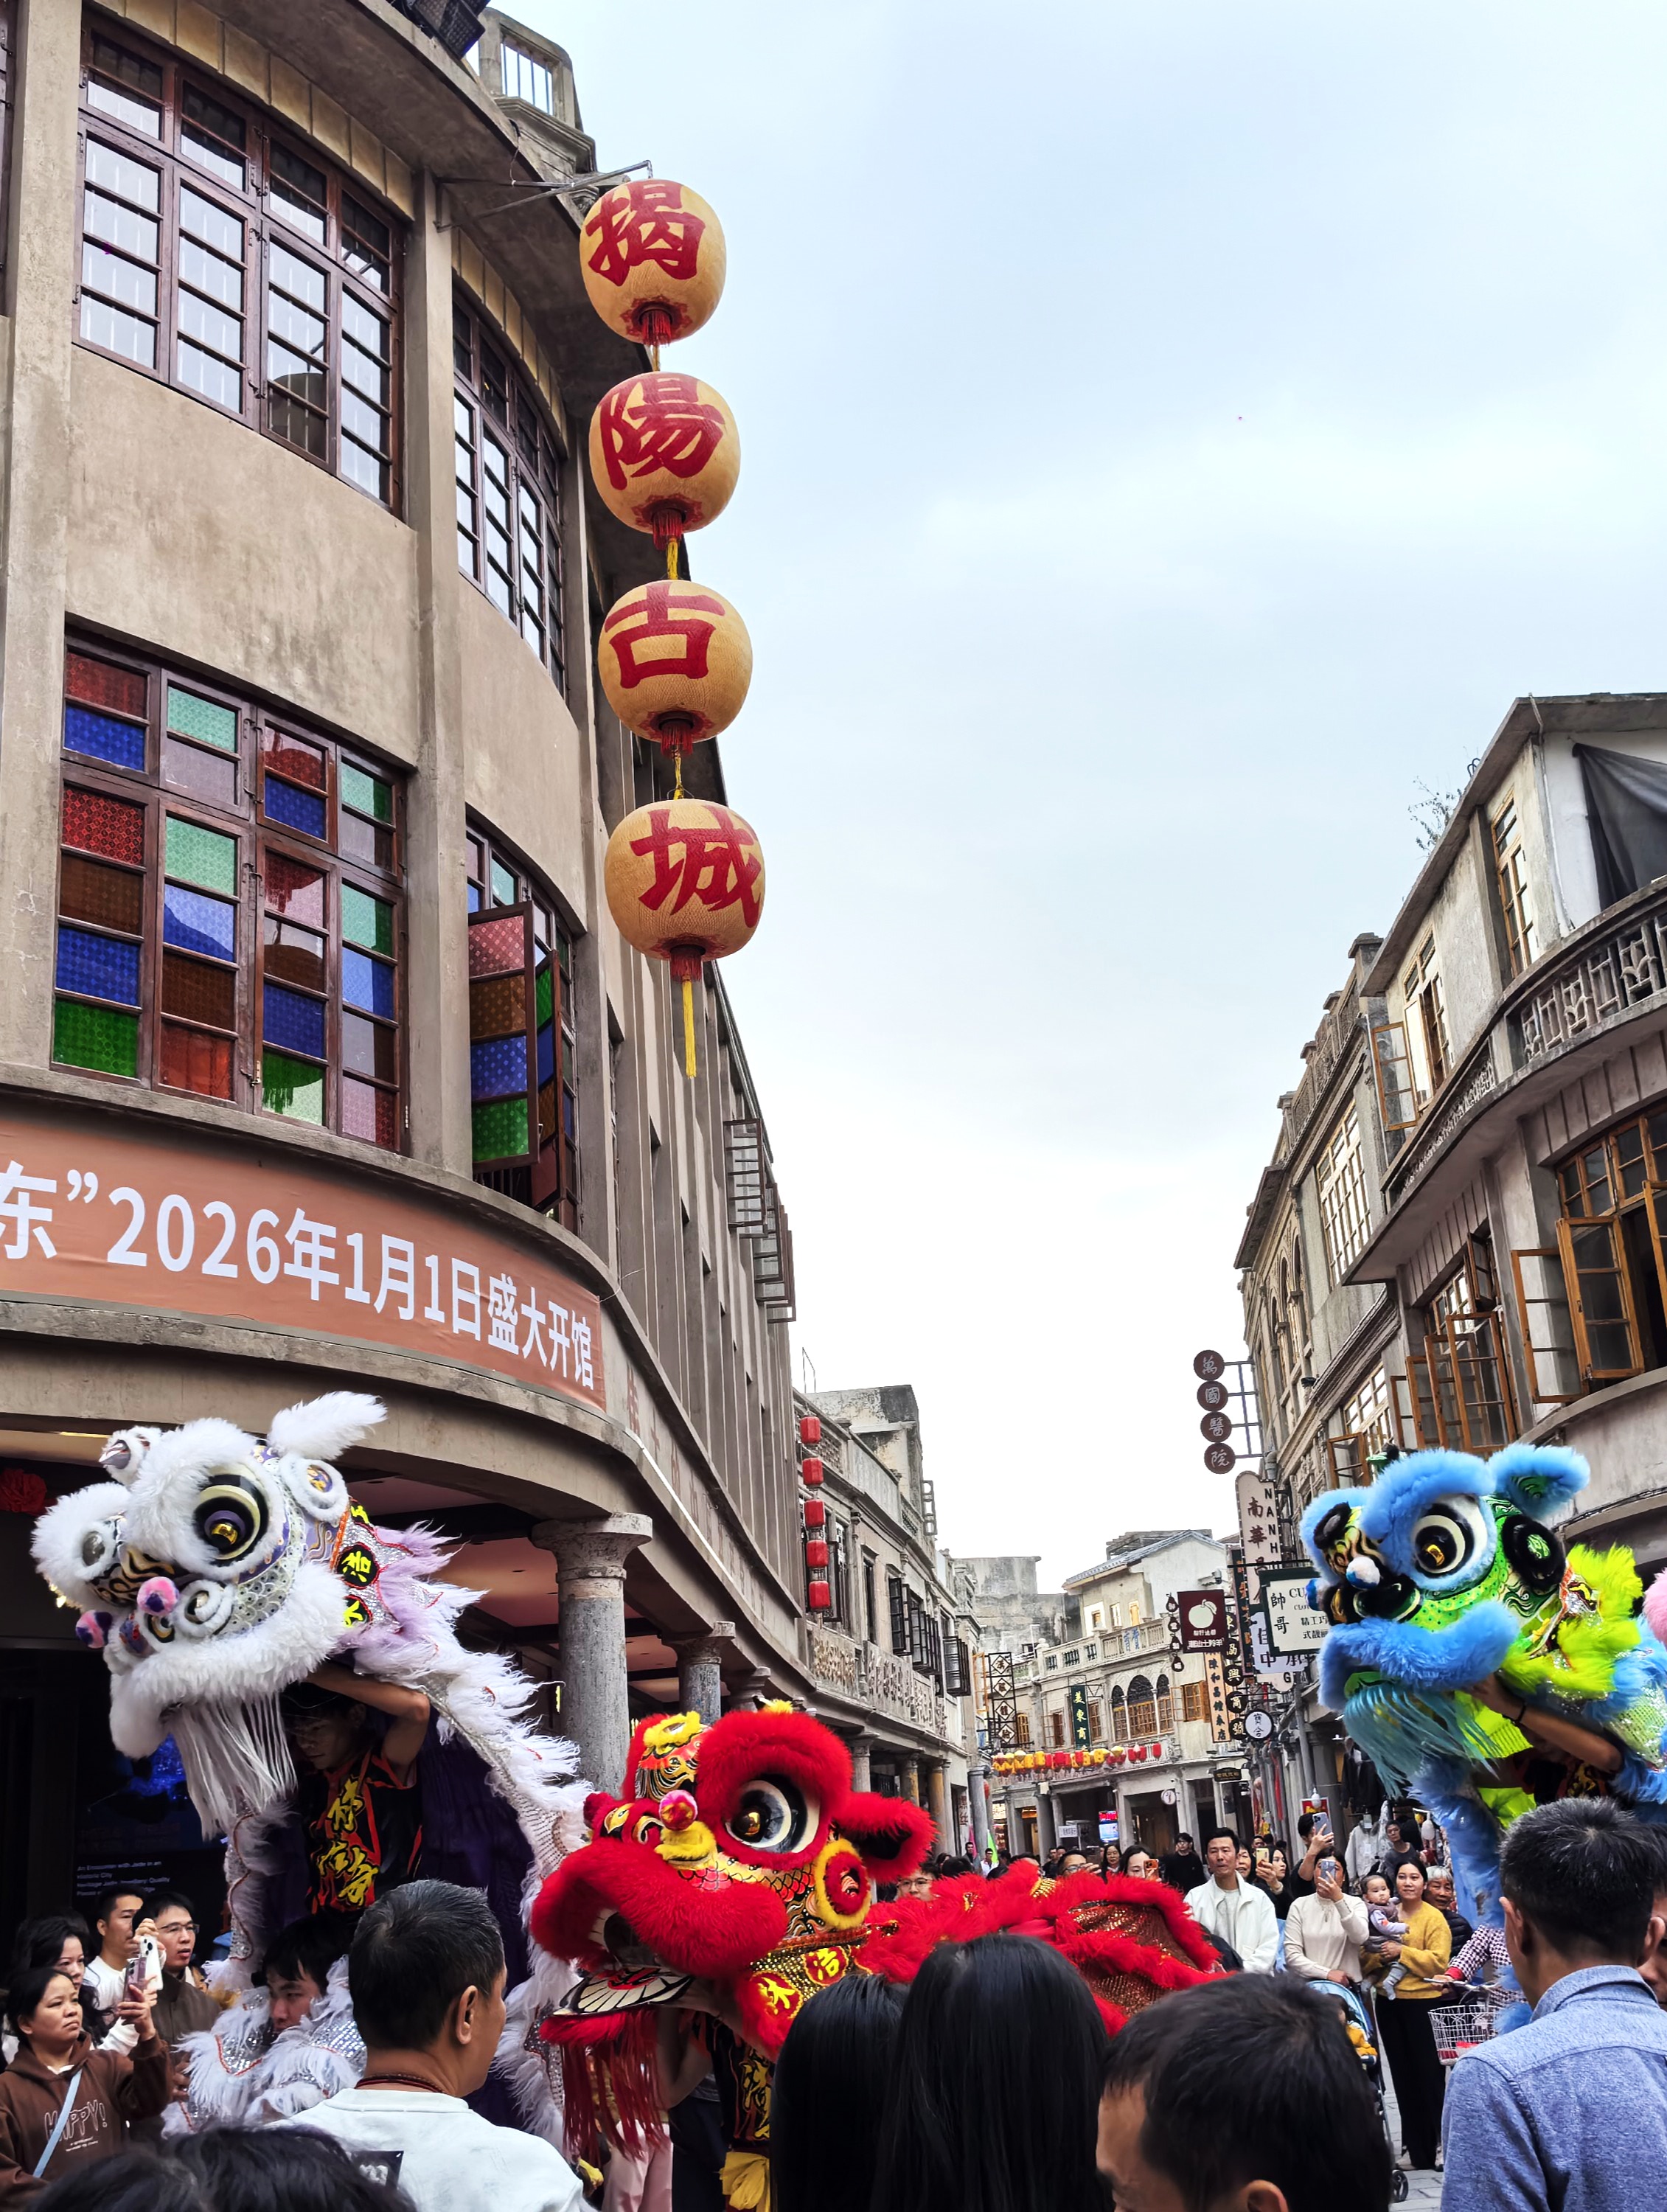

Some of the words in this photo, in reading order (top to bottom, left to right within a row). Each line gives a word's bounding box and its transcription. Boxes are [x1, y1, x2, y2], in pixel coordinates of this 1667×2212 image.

[585, 180, 763, 929] 揭陽古城
[1270, 1592, 1290, 1634] 帥哥
